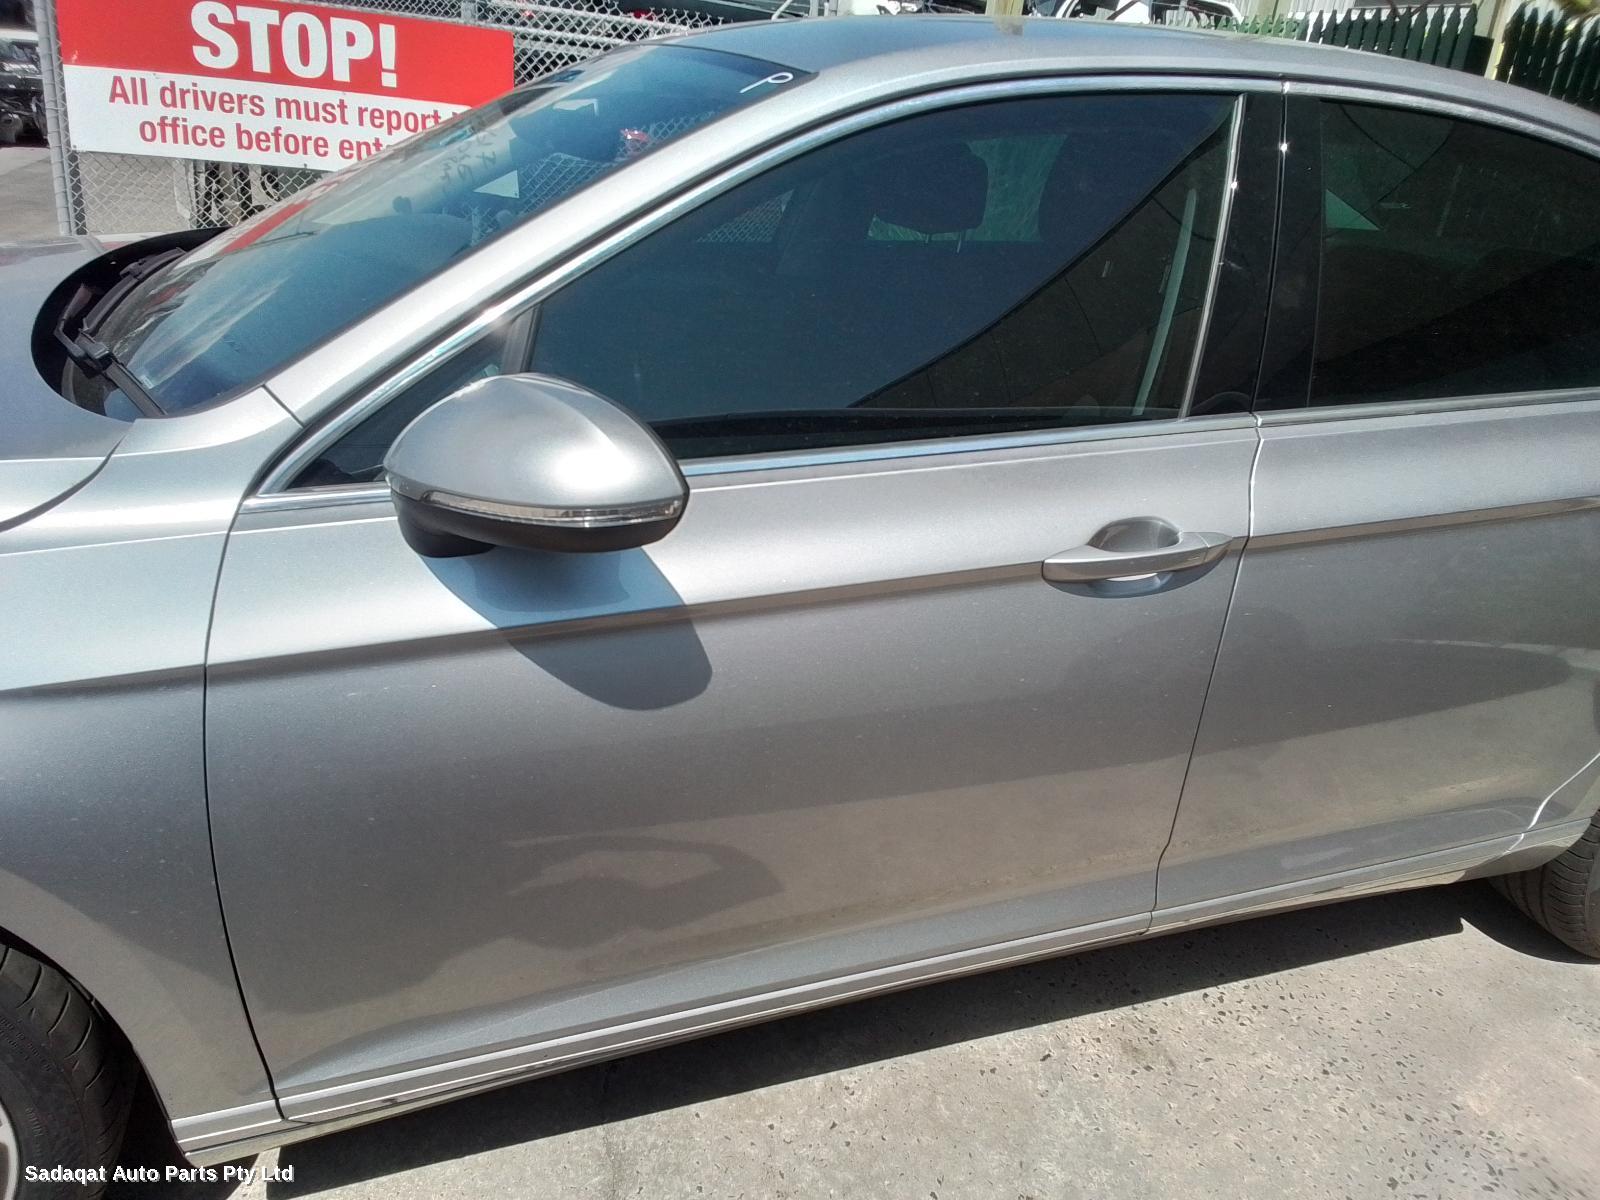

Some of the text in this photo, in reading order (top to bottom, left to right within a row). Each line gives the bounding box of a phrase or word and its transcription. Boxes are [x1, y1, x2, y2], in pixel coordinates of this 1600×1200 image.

[190, 1, 397, 88] STOP!
[109, 76, 442, 136] All drivers must report
[139, 115, 393, 161] office before ent
